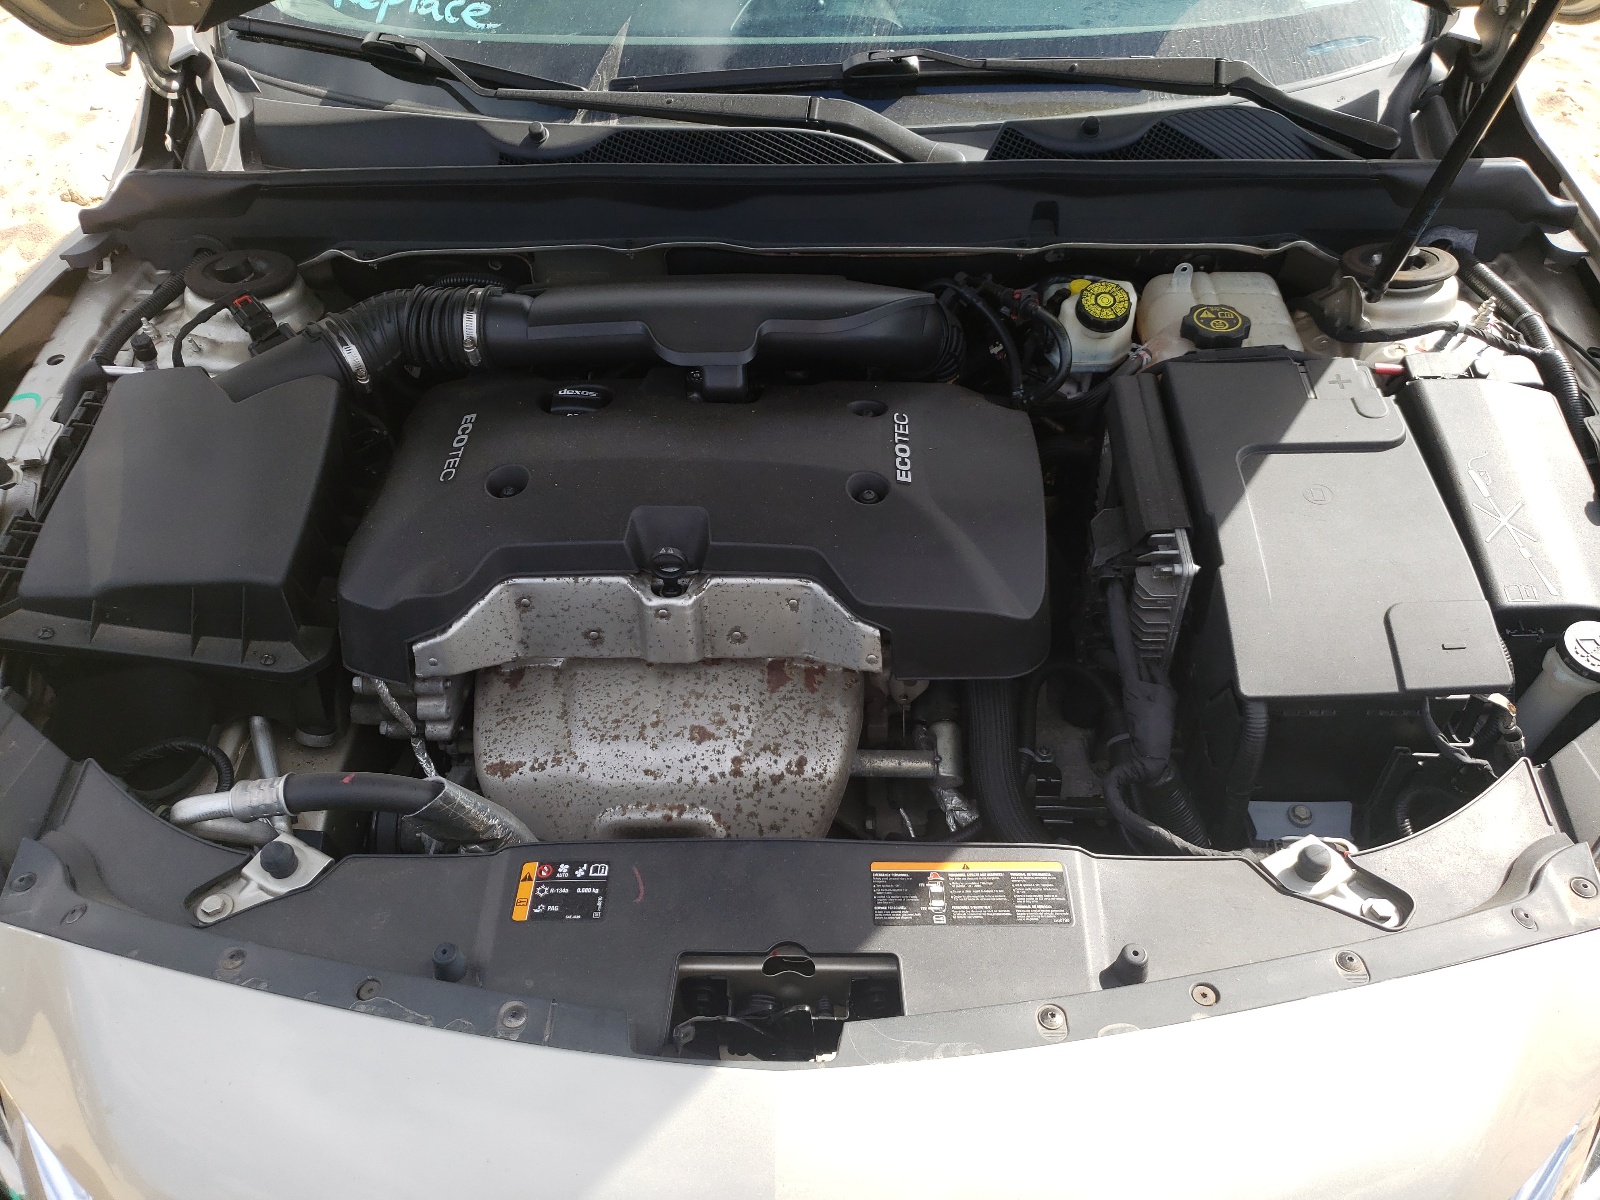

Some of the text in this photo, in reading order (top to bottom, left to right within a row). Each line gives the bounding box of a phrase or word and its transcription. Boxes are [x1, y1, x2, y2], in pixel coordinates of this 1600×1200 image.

[558, 388, 598, 397] dexos
[439, 413, 477, 482] ECOTEC
[893, 412, 912, 483] ECOTEC
